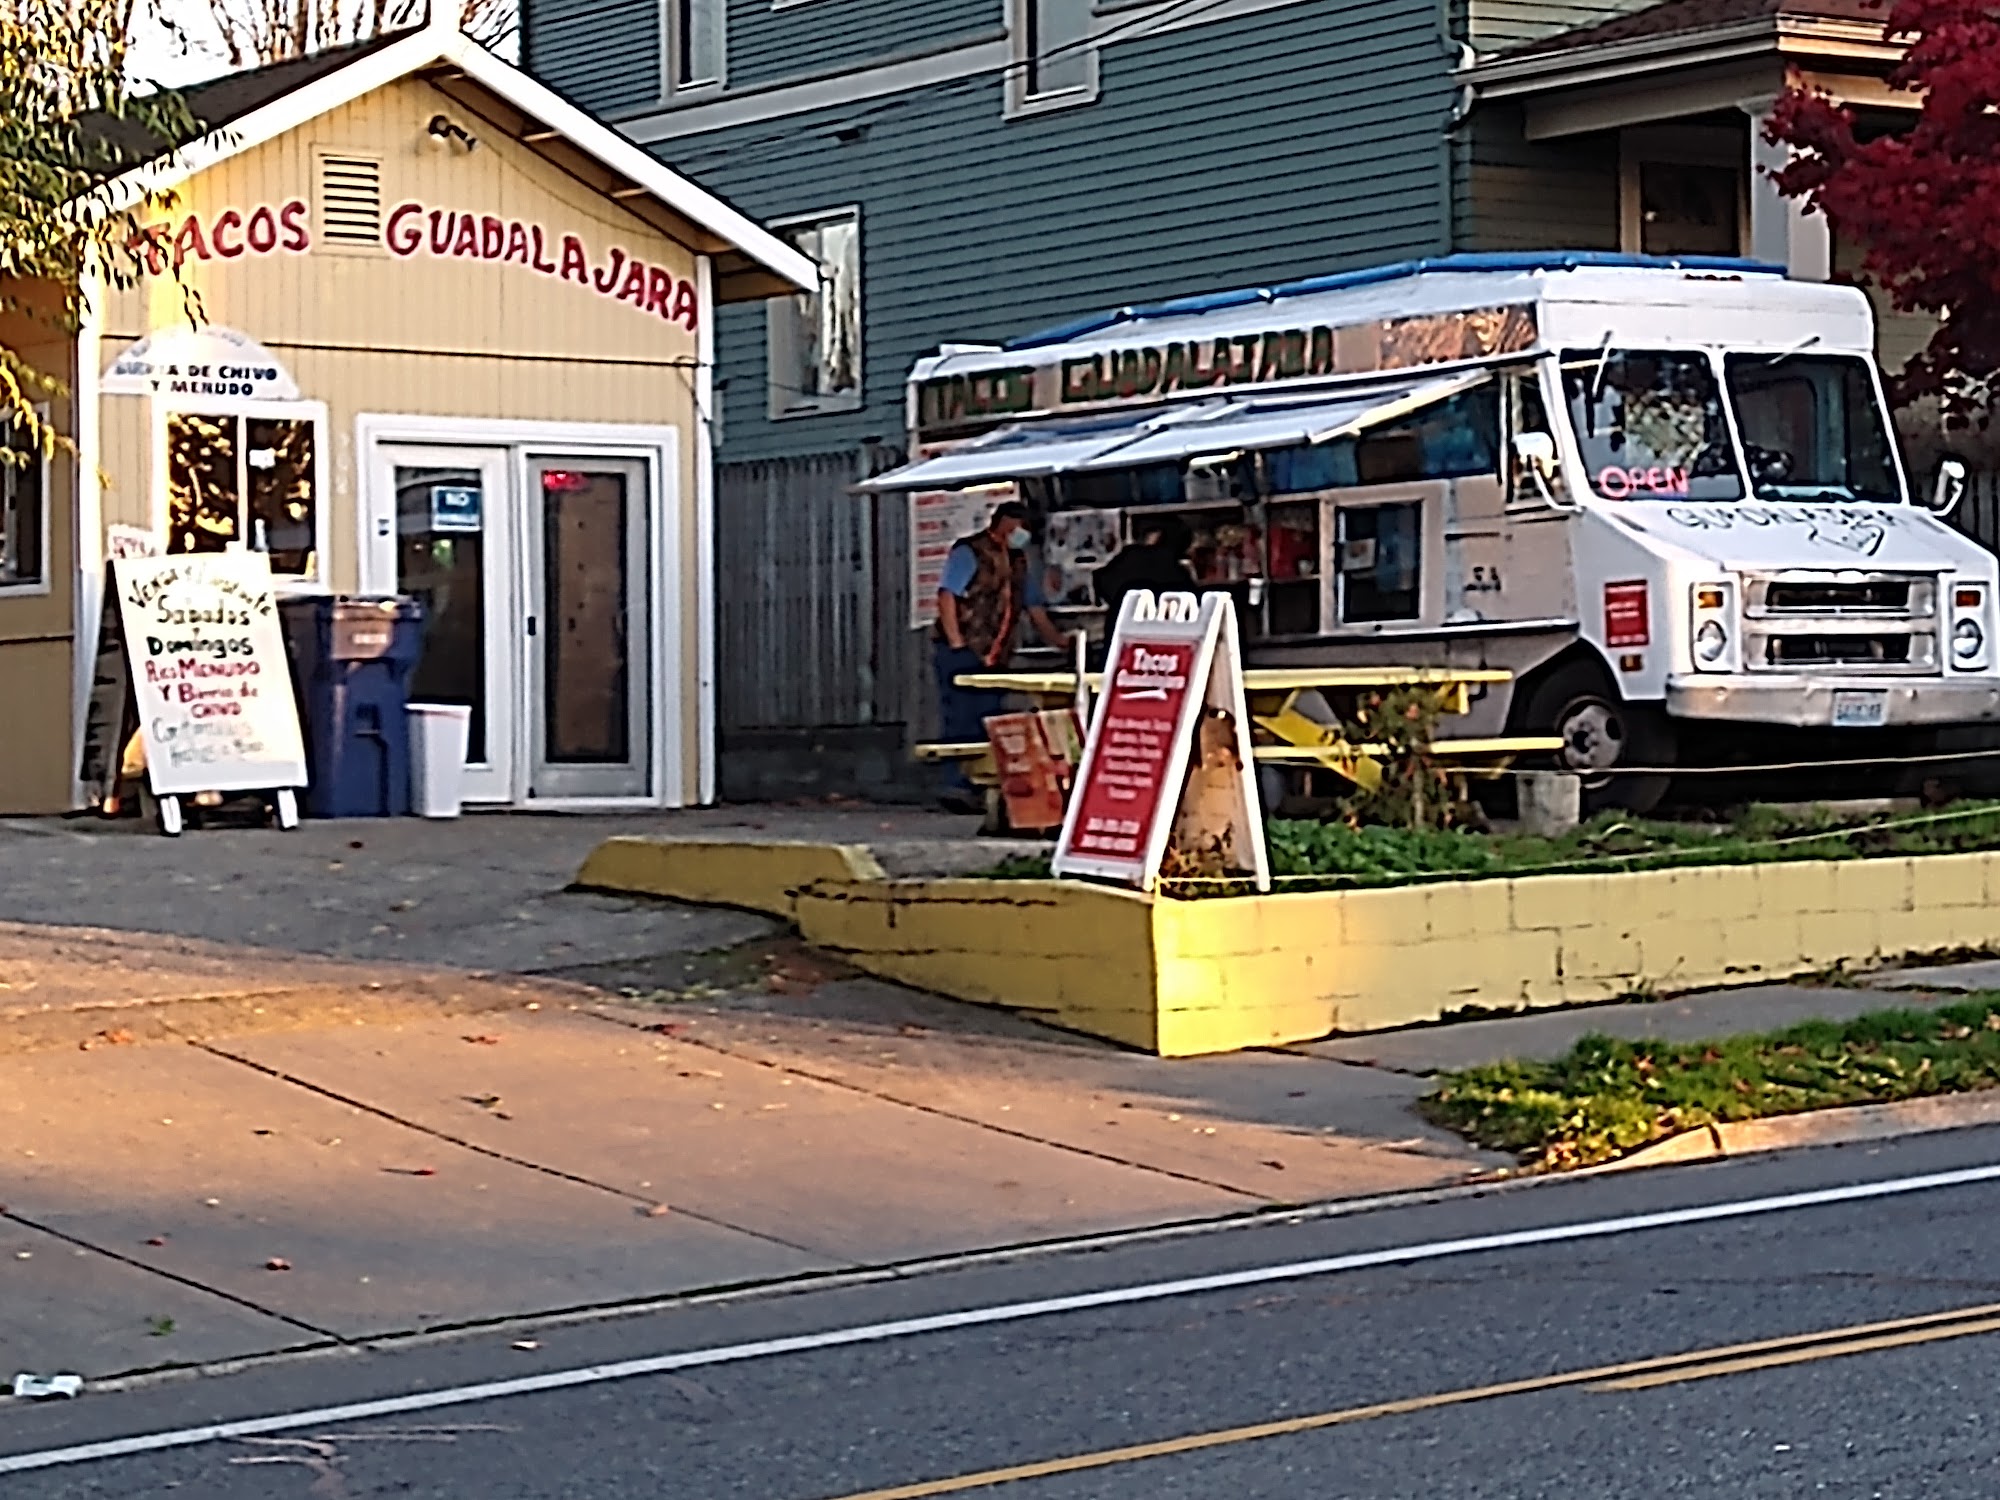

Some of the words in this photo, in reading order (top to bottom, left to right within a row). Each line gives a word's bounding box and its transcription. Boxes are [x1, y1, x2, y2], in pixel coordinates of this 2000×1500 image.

[127, 200, 309, 275] TACOS
[386, 203, 698, 331] GUADALAJARA
[188, 365, 210, 377] DE
[219, 365, 278, 380] CHIVO
[151, 380, 160, 391] Y
[171, 381, 253, 395] MENUDO
[1598, 465, 1689, 498] OPEN
[445, 492, 470, 507] NO
[147, 636, 254, 659] Domingos
